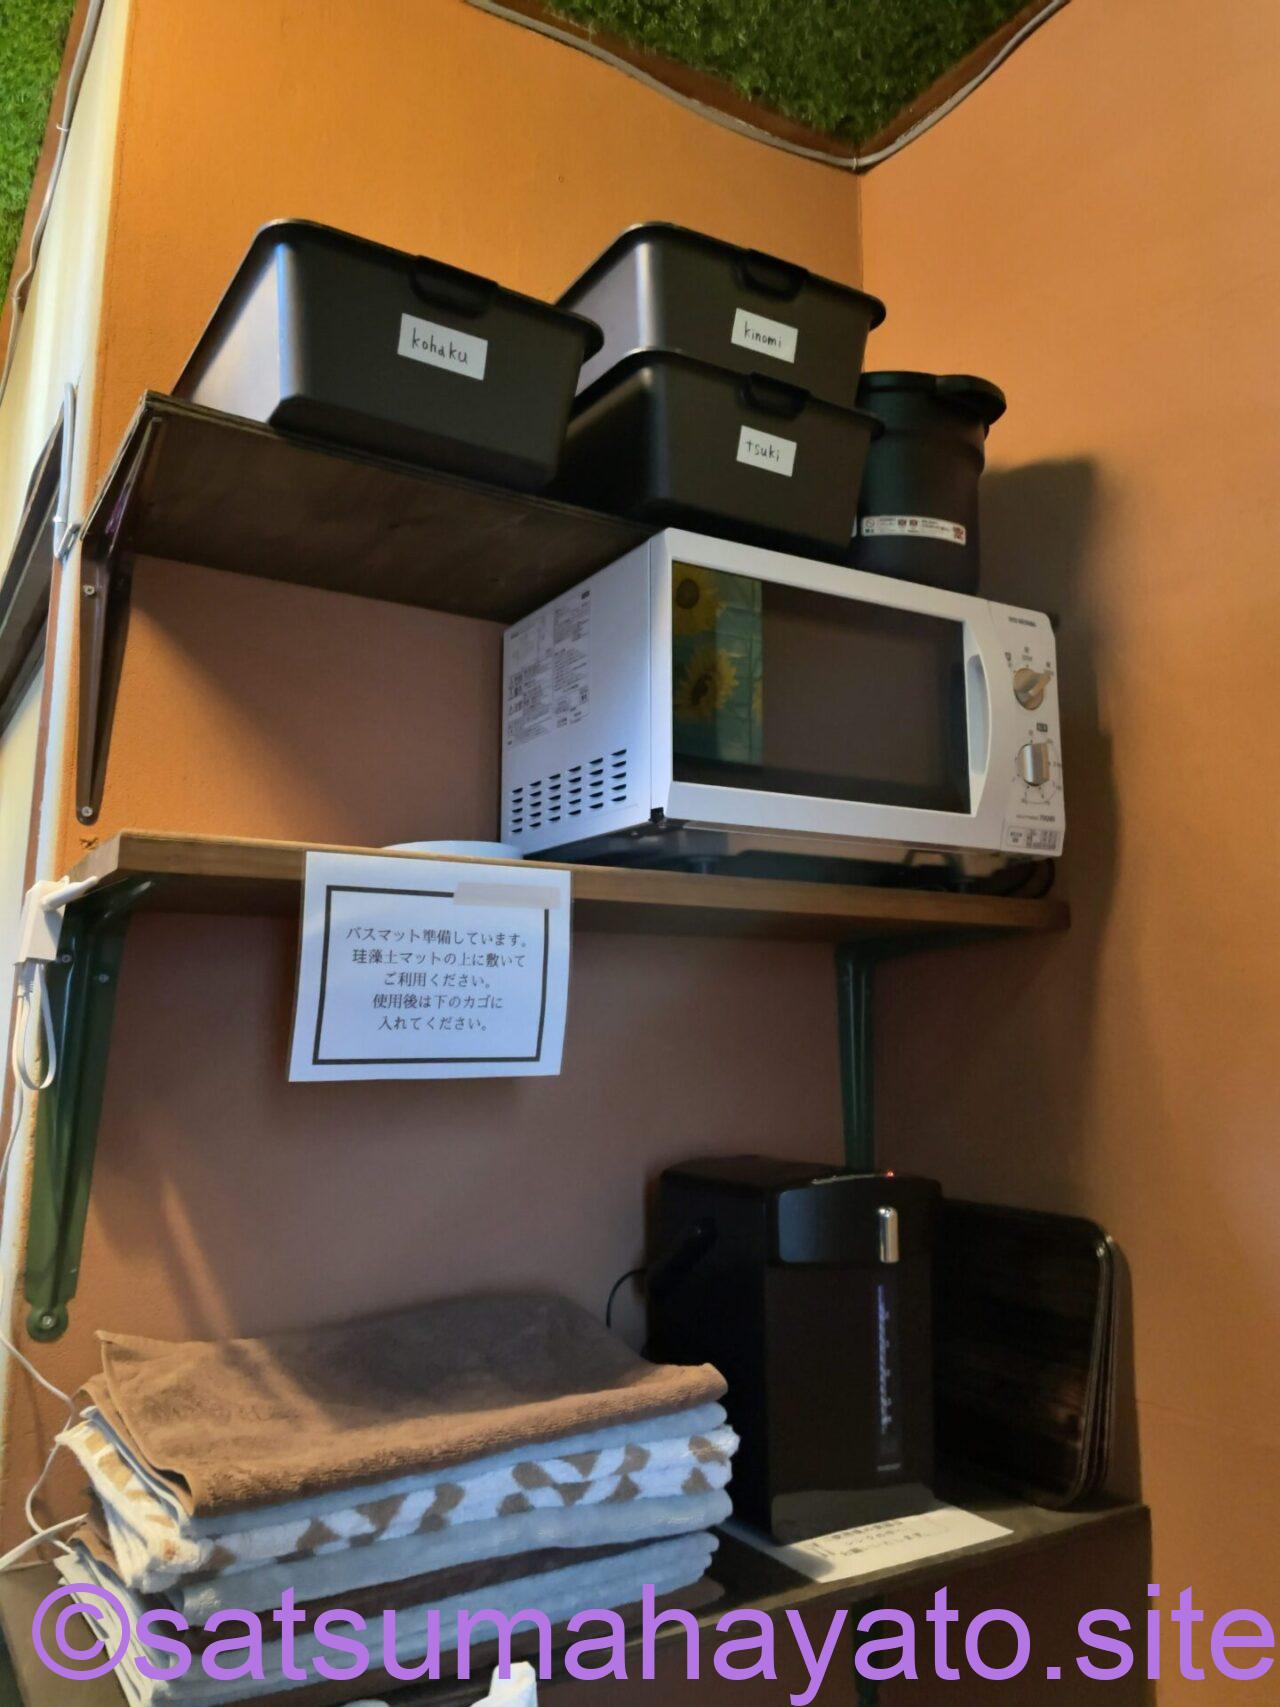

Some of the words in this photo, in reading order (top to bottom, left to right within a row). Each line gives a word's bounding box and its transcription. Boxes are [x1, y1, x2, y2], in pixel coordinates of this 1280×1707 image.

[743, 321, 783, 349] kinomi
[411, 327, 468, 365] kohaku
[745, 440, 780, 462] tsuki
[346, 927, 528, 948] バスマット準備しています。
[351, 948, 526, 968] 珪藻土マットの上に敷いて
[383, 971, 492, 989] ご利用ください。
[372, 993, 504, 1010] 使用後は下のカゴに
[377, 1015, 488, 1032] 入れてください。
